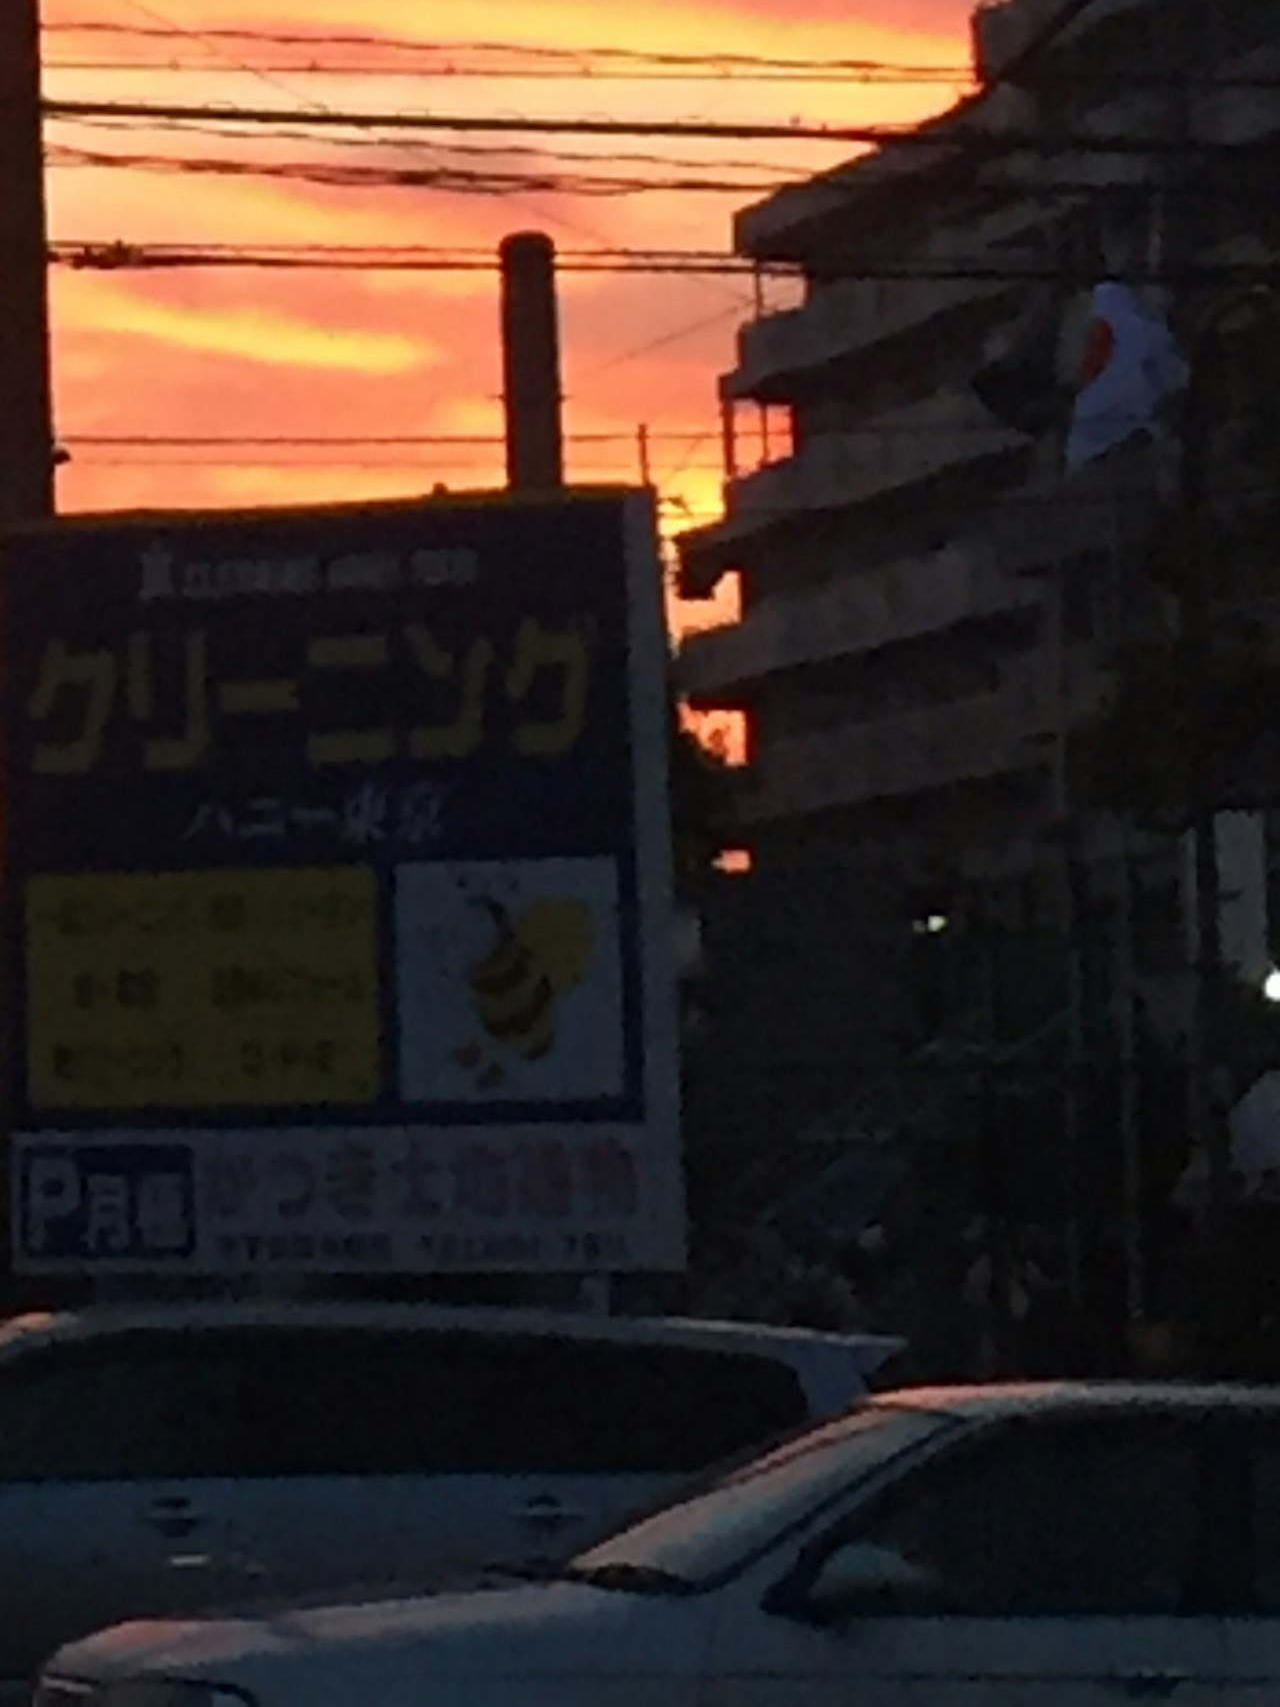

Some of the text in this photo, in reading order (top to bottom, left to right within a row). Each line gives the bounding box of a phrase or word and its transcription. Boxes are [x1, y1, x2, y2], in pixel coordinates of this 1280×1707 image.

[29, 616, 596, 776] クリーニング
